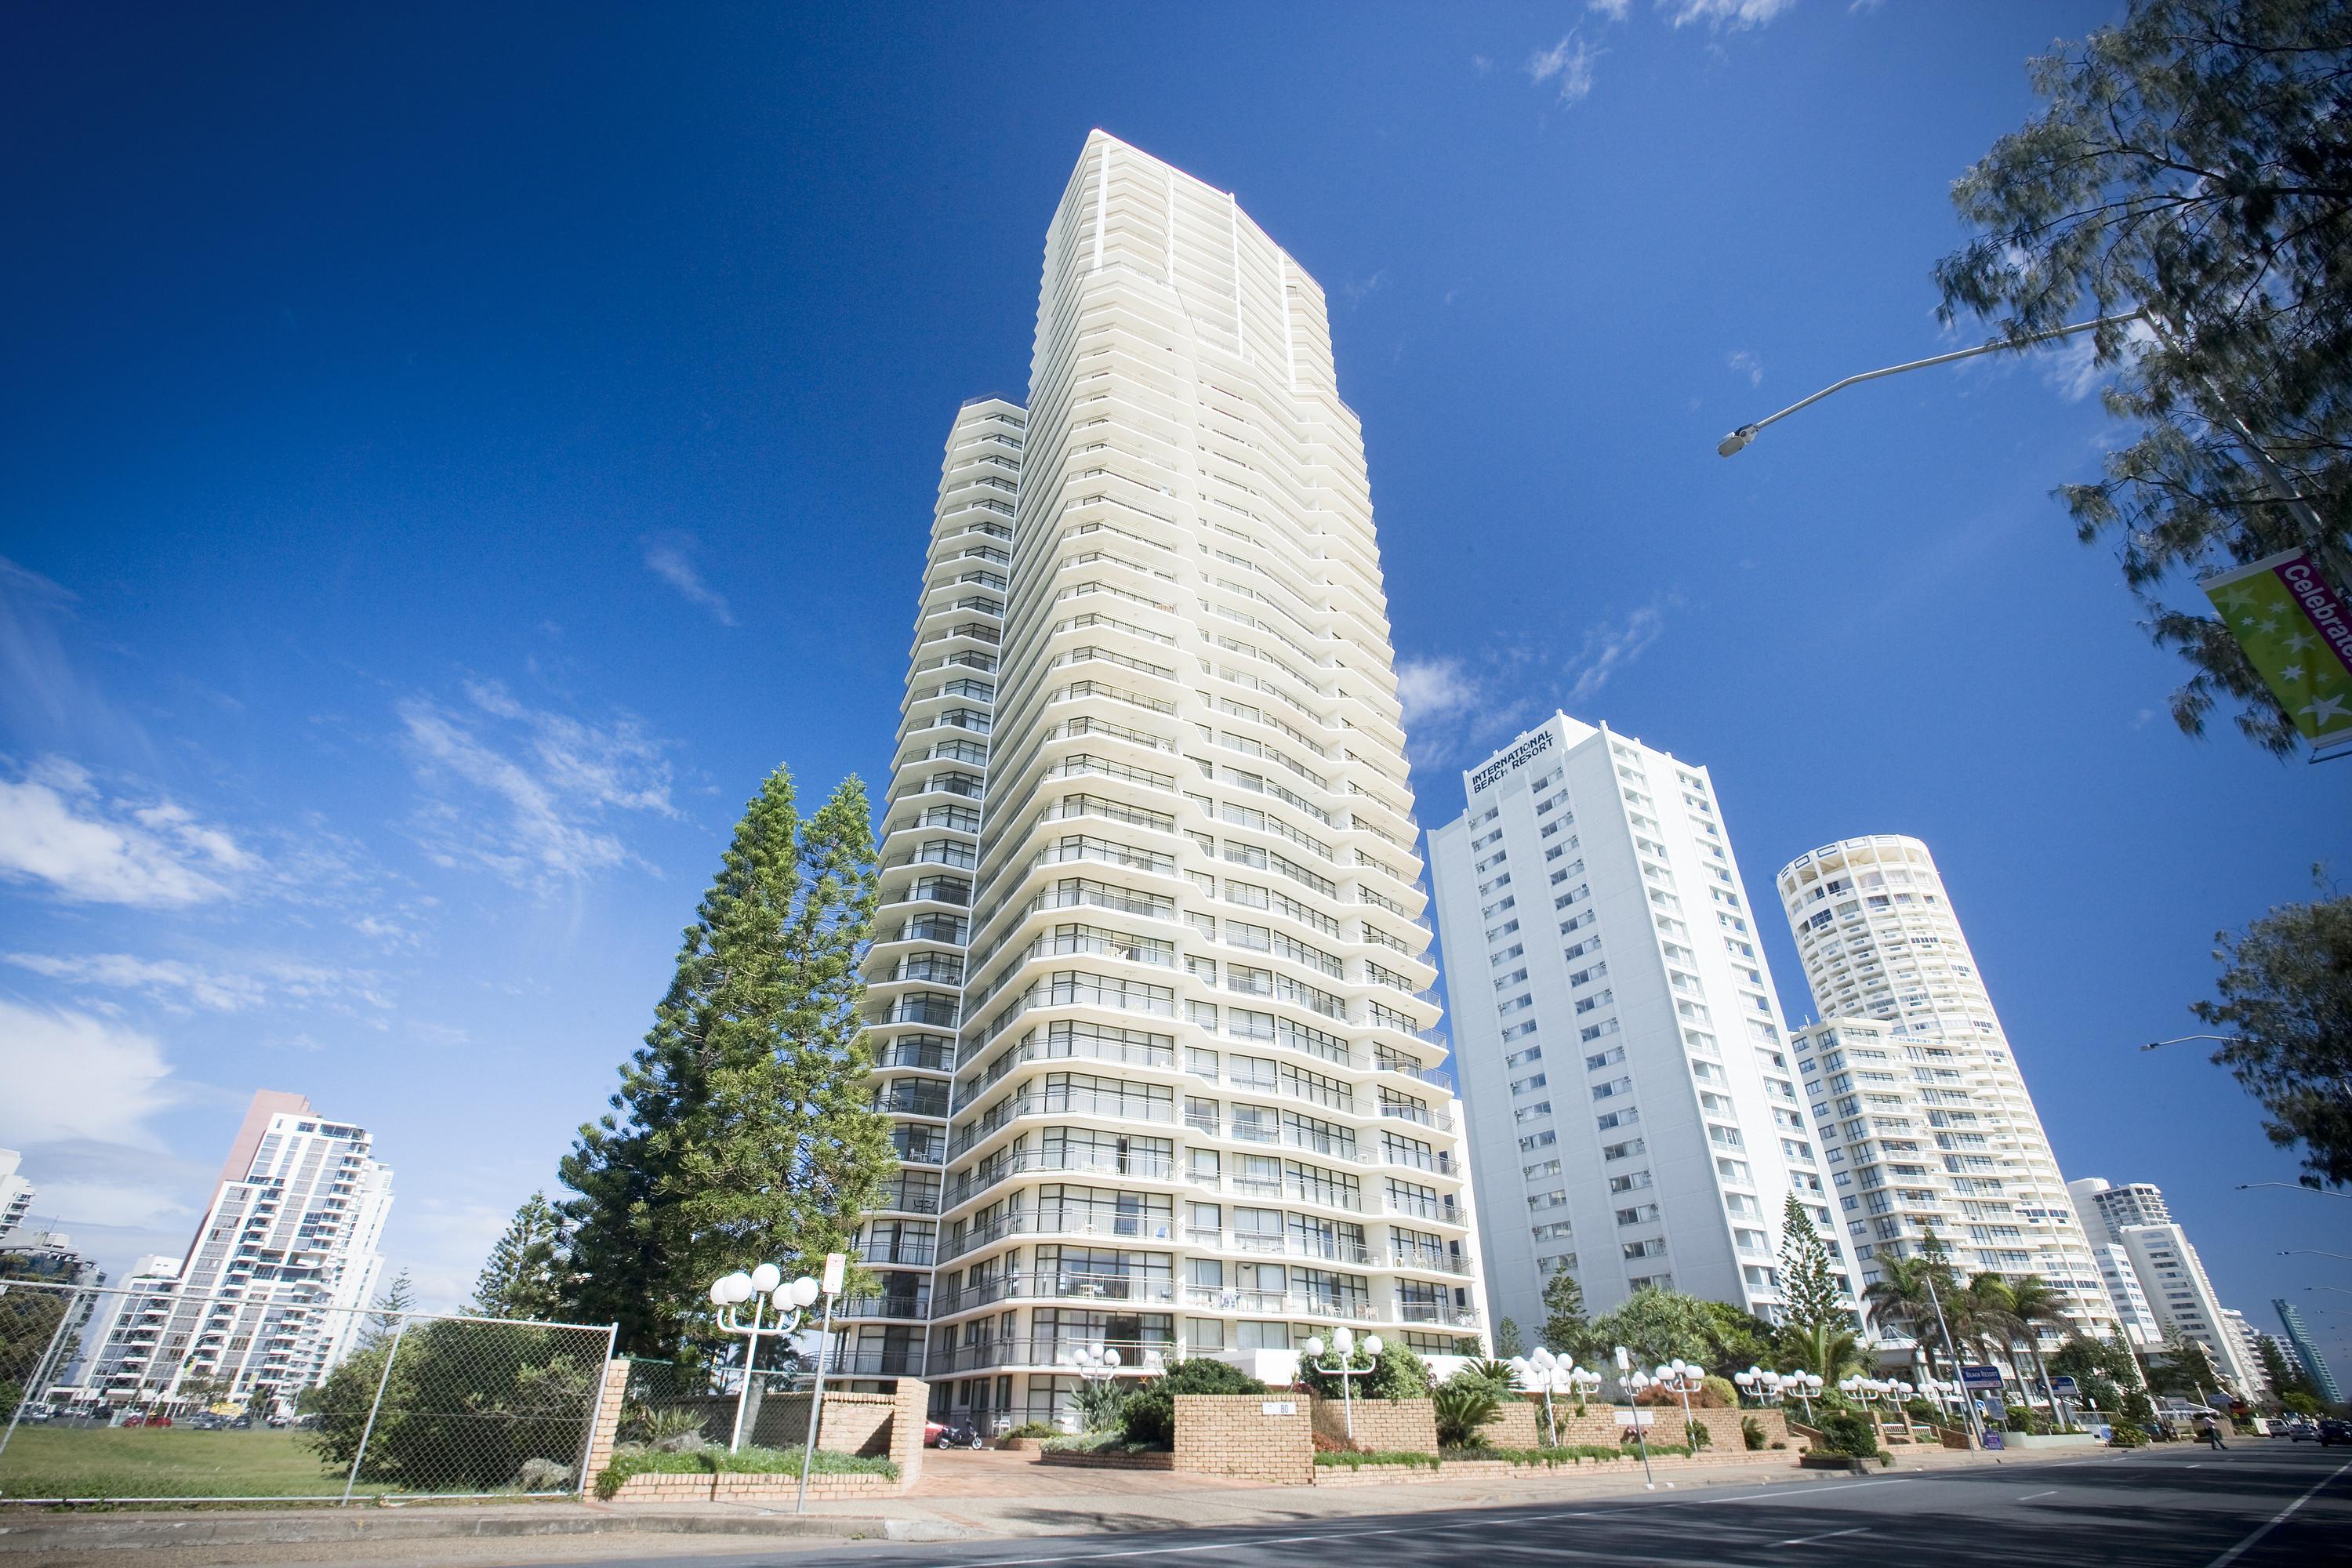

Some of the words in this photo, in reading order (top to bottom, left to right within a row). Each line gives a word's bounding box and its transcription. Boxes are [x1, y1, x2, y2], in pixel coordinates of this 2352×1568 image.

[2285, 564, 2352, 664] Celebrate
[1472, 731, 1553, 786] INTERNATIONAL
[1474, 768, 1508, 793] BEACH
[1512, 737, 1554, 770] RESORT
[1780, 836, 1896, 879] FOCUS
[1280, 1404, 1288, 1414] 80
